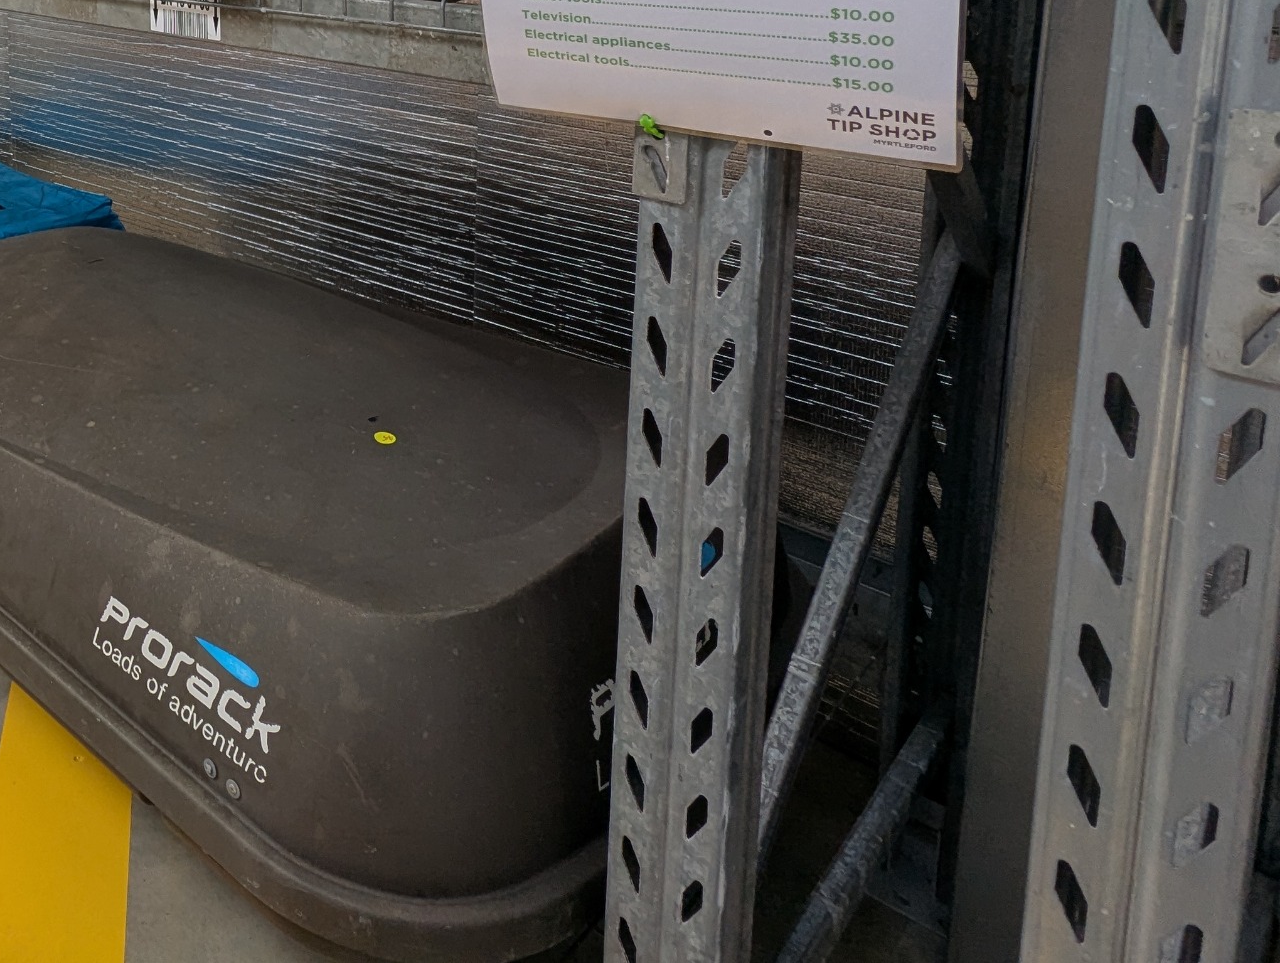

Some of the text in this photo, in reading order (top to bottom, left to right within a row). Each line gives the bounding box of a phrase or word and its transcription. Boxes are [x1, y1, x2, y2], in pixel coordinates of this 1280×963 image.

[522, 10, 895, 47] Television $35.00
[830, 7, 895, 23] $10.00
[524, 29, 894, 70] Electrical appliances $10.00
[527, 48, 894, 93] Electrical tools $15.00
[826, 118, 937, 142] TIP SHOP
[847, 105, 935, 127] ALPINE
[873, 139, 937, 152] MYRTLEFORD
[100, 595, 281, 754] Prorack
[92, 627, 267, 784] Loads of adventure
